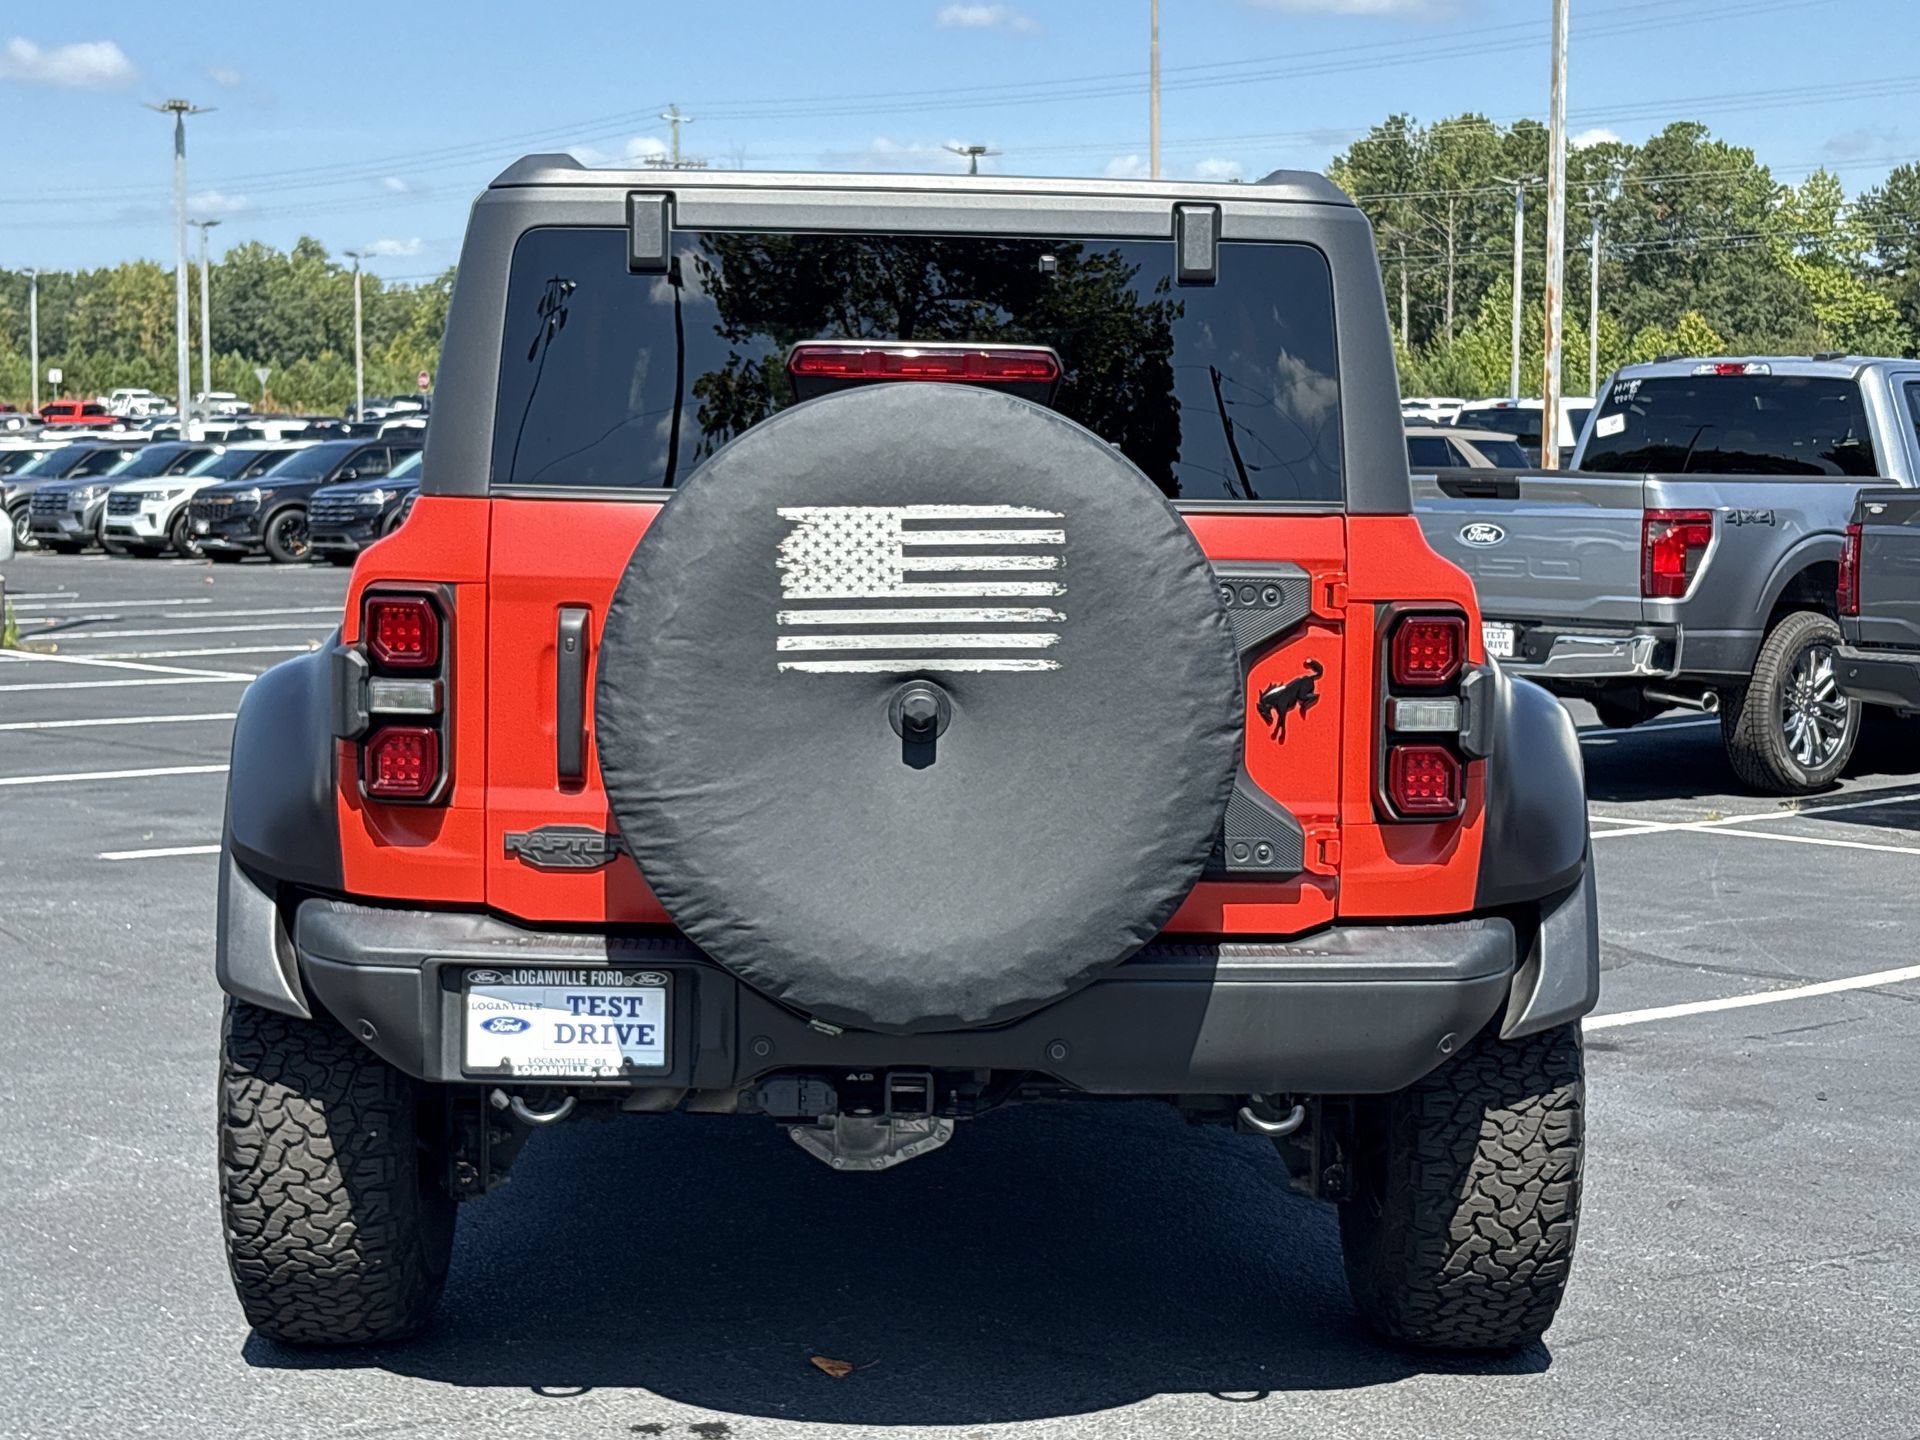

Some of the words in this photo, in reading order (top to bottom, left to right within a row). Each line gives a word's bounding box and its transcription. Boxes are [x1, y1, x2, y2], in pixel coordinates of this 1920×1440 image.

[1467, 526, 1497, 541] Ford
[512, 969, 587, 985] LOGANVILLE
[590, 970, 623, 986] FORD
[471, 1001, 543, 1011] LOGANVILLE
[566, 995, 643, 1017] TEST
[489, 1018, 523, 1032] Ford
[554, 1023, 655, 1045] DRIVE
[599, 1065, 620, 1076] GA
